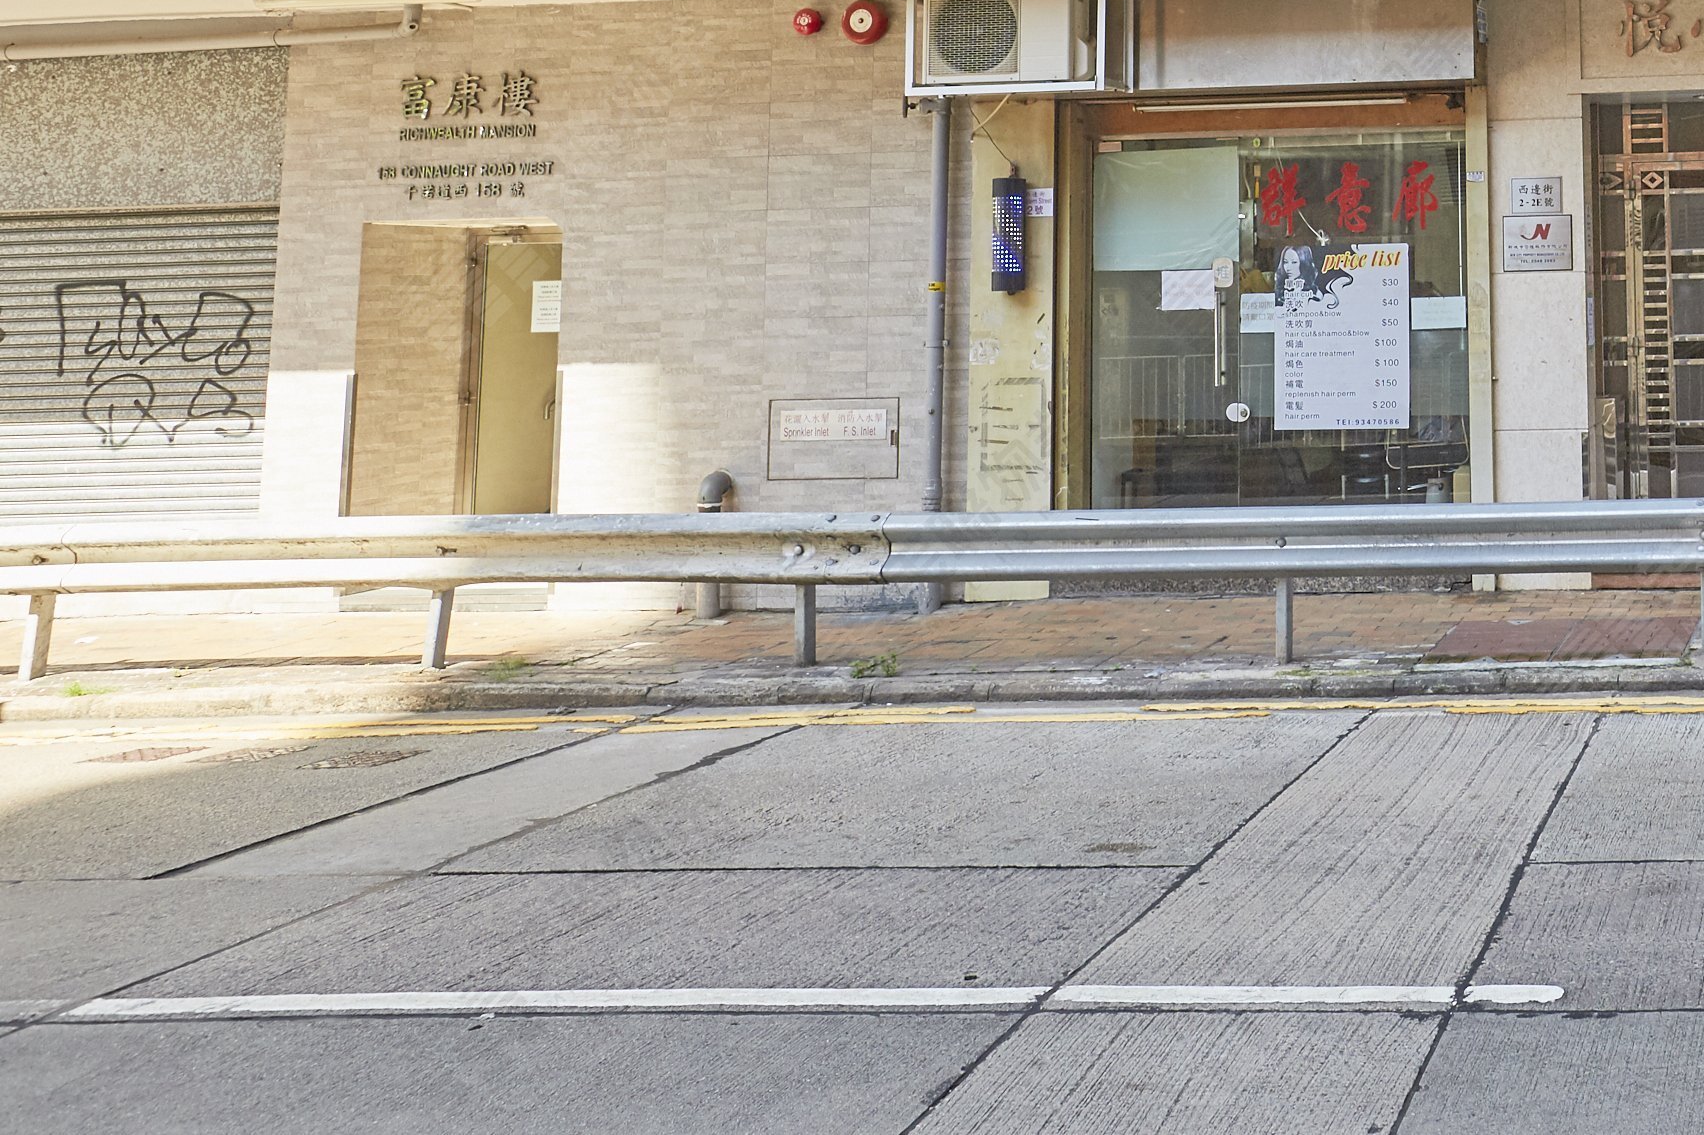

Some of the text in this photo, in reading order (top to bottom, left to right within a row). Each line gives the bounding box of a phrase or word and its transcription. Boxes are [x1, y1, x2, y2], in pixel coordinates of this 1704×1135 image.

[401, 70, 542, 121] 富康樓
[400, 124, 537, 141] RICHWEALTH MANSION
[378, 161, 555, 180] 158 CONNAUGHT ROAD WEST
[476, 183, 502, 198] 158
[1518, 184, 1554, 196] 西邊街
[1321, 250, 1401, 274] price list
[1382, 279, 1398, 287] $30
[1285, 299, 1304, 309] 洗吹
[1382, 299, 1398, 307] $40
[1285, 319, 1313, 329] 洗吹剪
[1382, 318, 1398, 326] $50
[1375, 339, 1397, 347] $100
[1375, 379, 1397, 387] $150
[1285, 390, 1319, 398] replenish
[783, 427, 814, 439] Sprinkler
[815, 426, 829, 437] Inlet
[860, 426, 876, 436] Inlet
